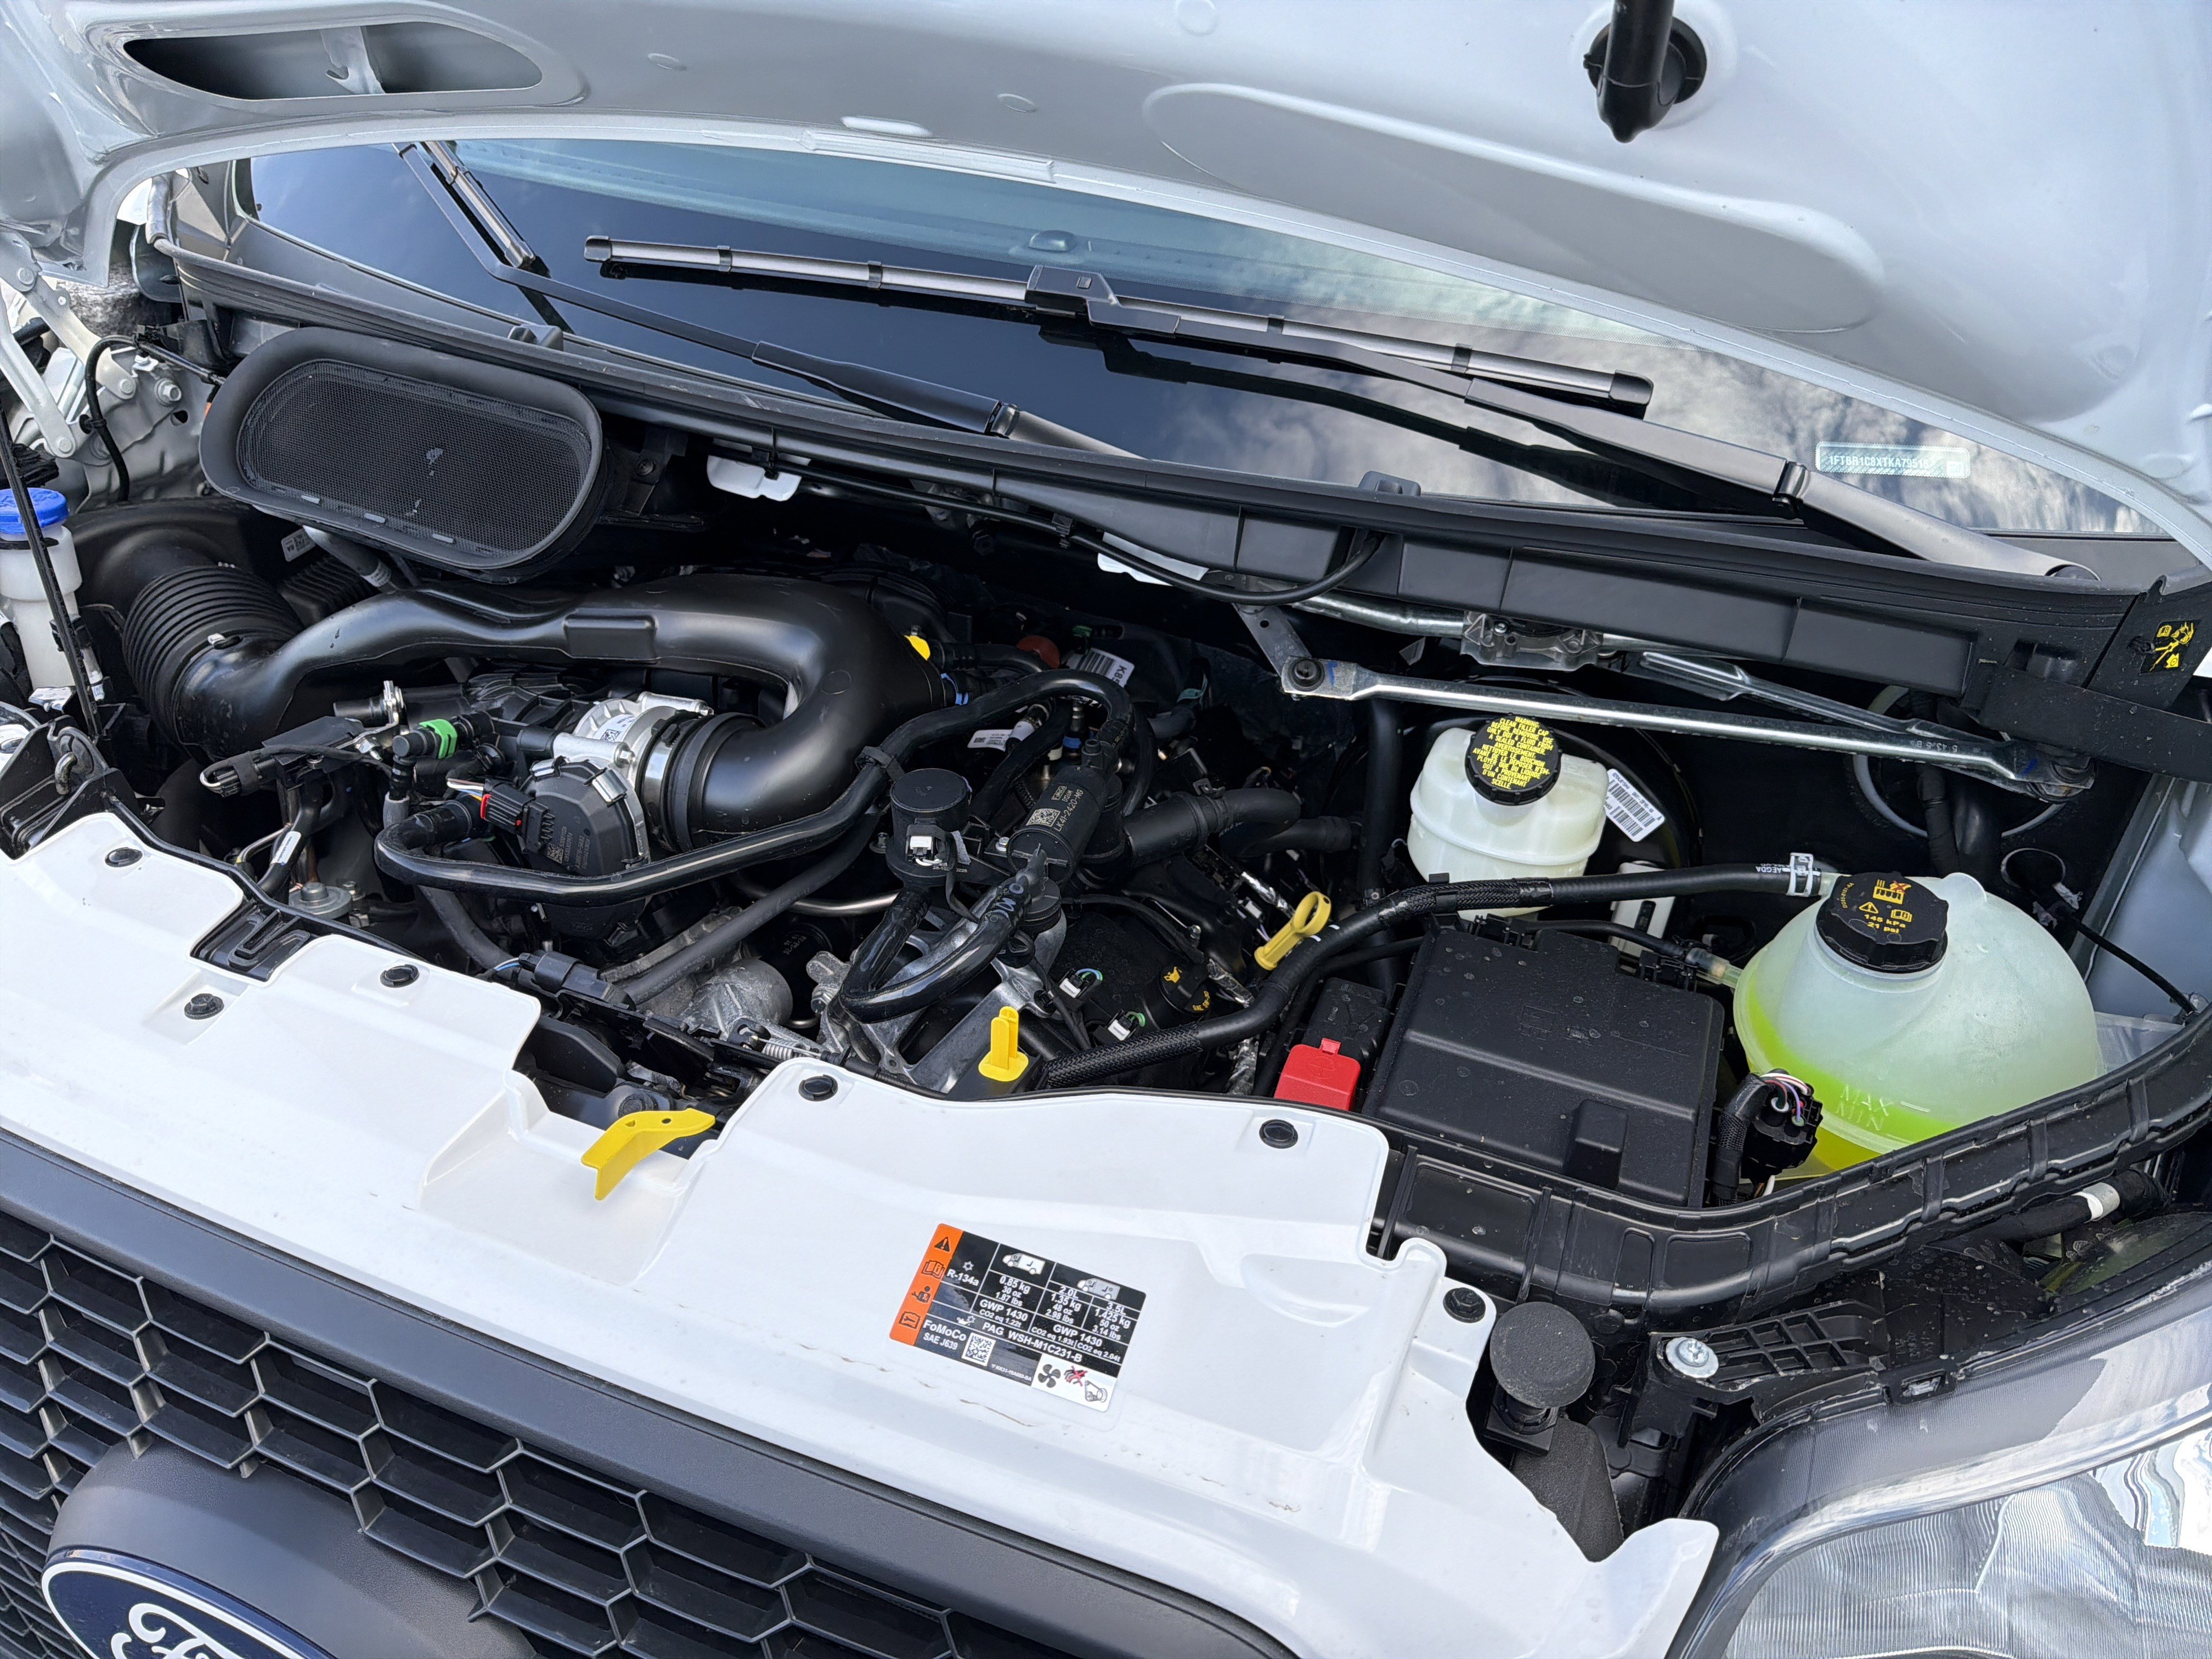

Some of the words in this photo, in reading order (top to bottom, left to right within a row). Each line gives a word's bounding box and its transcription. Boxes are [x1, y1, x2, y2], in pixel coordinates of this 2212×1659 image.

[1491, 721, 1511, 731] BEFORE
[1500, 718, 1517, 727] CLEAN
[1518, 724, 1536, 732] FILLER
[1495, 736, 1515, 745] SEALED
[1521, 737, 1536, 745] FLUID
[1537, 742, 1553, 750] FROM
[1473, 748, 1490, 757] AVANT
[1482, 744, 1508, 756] NETTOYER
[1520, 755, 1545, 767] BOUCHON
[1477, 755, 1497, 765] PLOYER
[1520, 769, 1541, 778] LIQUIDE
[1497, 774, 1527, 786] CONTENANT
[1501, 769, 1531, 781] PROVENANT
[1886, 919, 1906, 928] kPa
[946, 1268, 980, 1286] R-134a
[998, 1275, 1019, 1289] 0.85
[1017, 1282, 1031, 1295] kg
[1001, 1285, 1011, 1295] 30
[1011, 1290, 1022, 1299] oz
[1058, 1286, 1080, 1299] 2.0L
[995, 1291, 1011, 1302] 1.87
[1011, 1297, 1023, 1307] lbs
[1049, 1293, 1069, 1306] 1.35
[1068, 1299, 1082, 1312] kg
[979, 1299, 1004, 1314] GWP
[1005, 1307, 1028, 1322] 1430
[979, 1308, 995, 1318] CO2
[994, 1314, 1005, 1323] eq
[1052, 1303, 1063, 1312] 48
[1063, 1307, 1073, 1316] oz
[1106, 1302, 1127, 1315] 3.5L
[1045, 1309, 1062, 1320] 2.98
[1062, 1314, 1075, 1324] lbs
[1094, 1308, 1118, 1323] 1.425
[1117, 1316, 1131, 1328] kg
[1099, 1319, 1110, 1328] 50
[923, 1319, 967, 1341] FoMoCo
[1031, 1326, 1046, 1336] CO2
[1045, 1331, 1057, 1341] eq
[1052, 1323, 1078, 1339] GWP
[1079, 1333, 1103, 1347] 1430
[1092, 1325, 1109, 1336] 3.14
[1108, 1330, 1122, 1341] lbs
[923, 1332, 939, 1344] SAE
[939, 1338, 958, 1351] J639
[982, 1323, 1004, 1336] PAG
[1006, 1330, 1083, 1363] WSH-M1C231-B
[1076, 1341, 1092, 1352] CO2
[1091, 1347, 1103, 1357] eq
